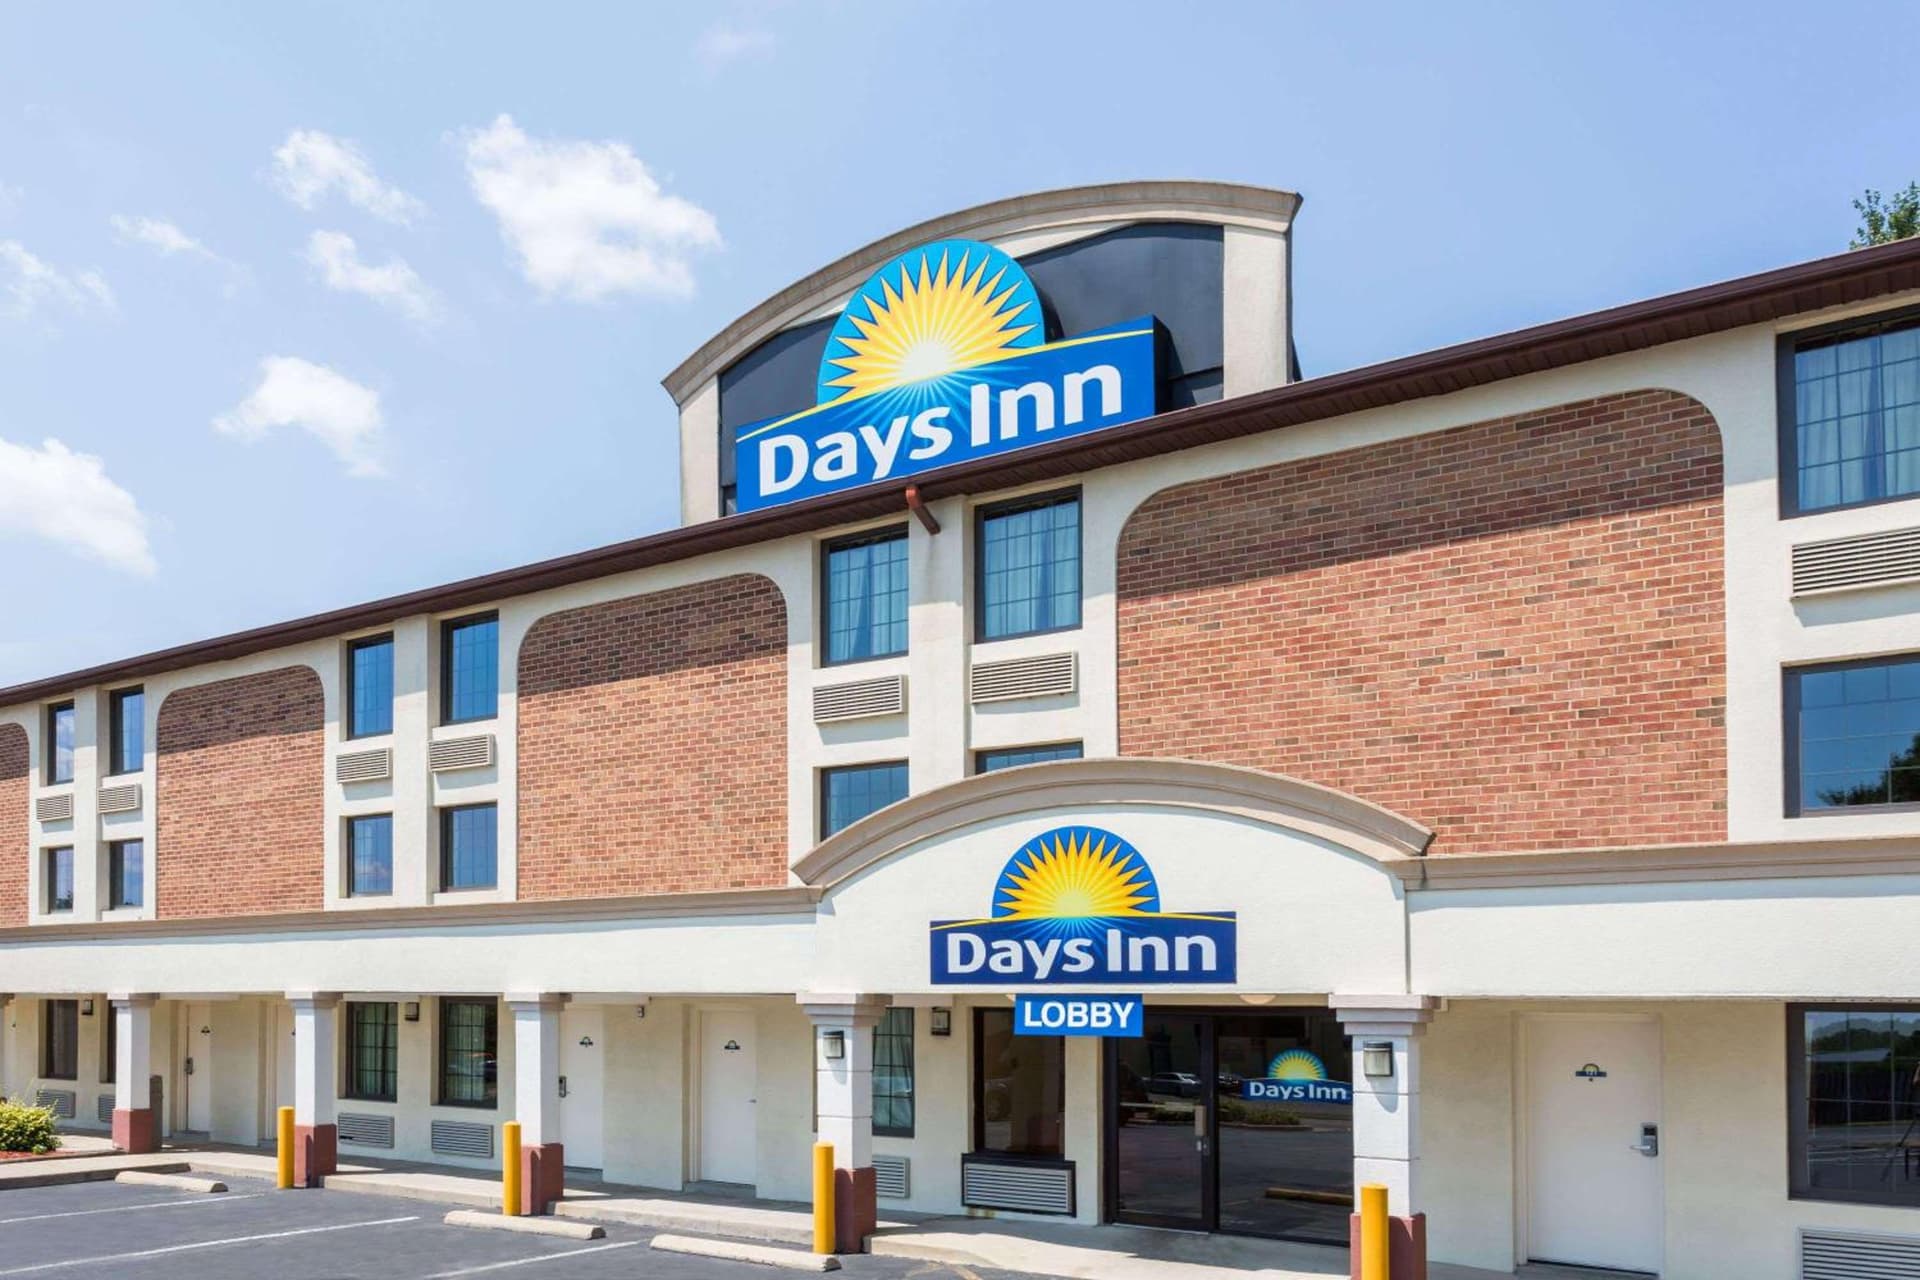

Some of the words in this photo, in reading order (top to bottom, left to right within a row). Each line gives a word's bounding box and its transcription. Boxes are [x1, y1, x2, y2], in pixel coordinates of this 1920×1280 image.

[759, 405, 953, 497] Days
[970, 364, 1123, 446] Inn
[947, 932, 1094, 979] Days
[1108, 929, 1217, 972] Inn
[1024, 1001, 1134, 1028] LOBBY
[1249, 1081, 1305, 1100] Days
[1308, 1083, 1347, 1100] Inn
